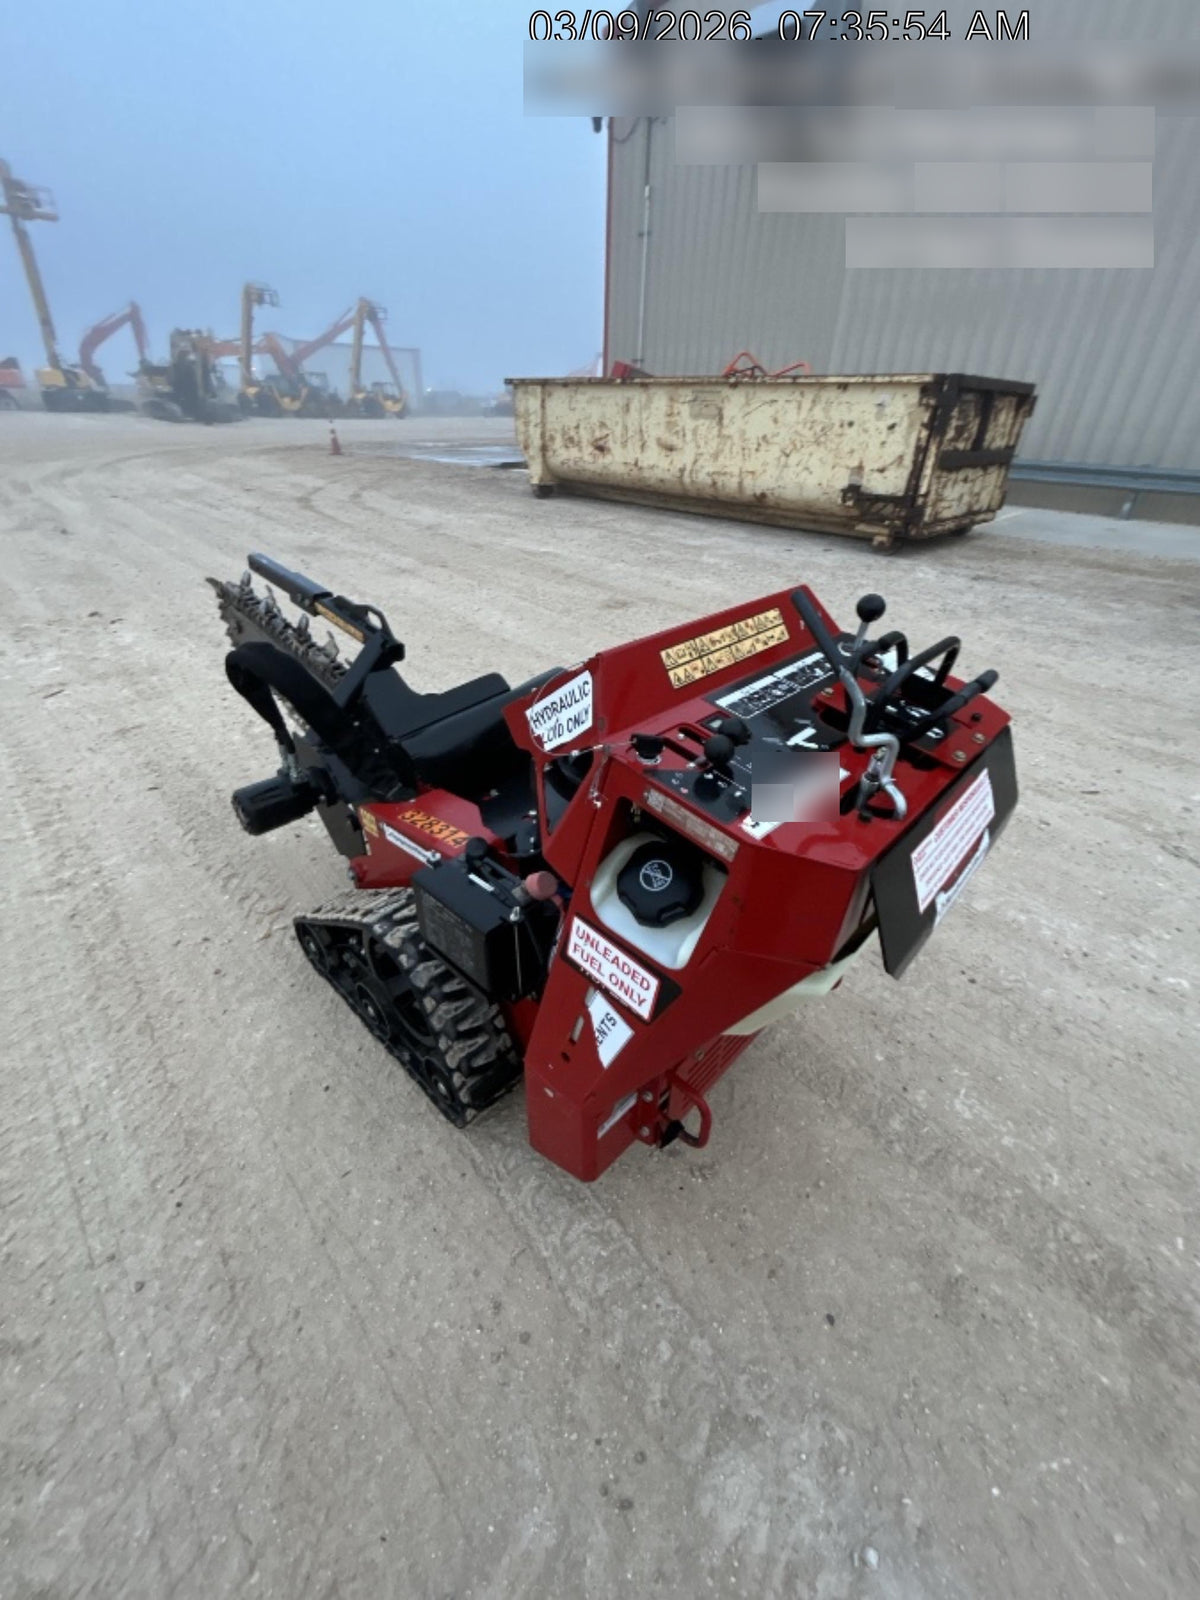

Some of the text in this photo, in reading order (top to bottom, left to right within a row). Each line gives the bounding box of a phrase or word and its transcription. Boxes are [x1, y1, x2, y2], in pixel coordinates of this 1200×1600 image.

[530, 680, 590, 730] HYDRAULIC
[541, 704, 591, 744] LUID ONLY
[572, 942, 606, 978] FUEL
[608, 972, 647, 1008] ONLY
[575, 925, 651, 992] UNLEADED
